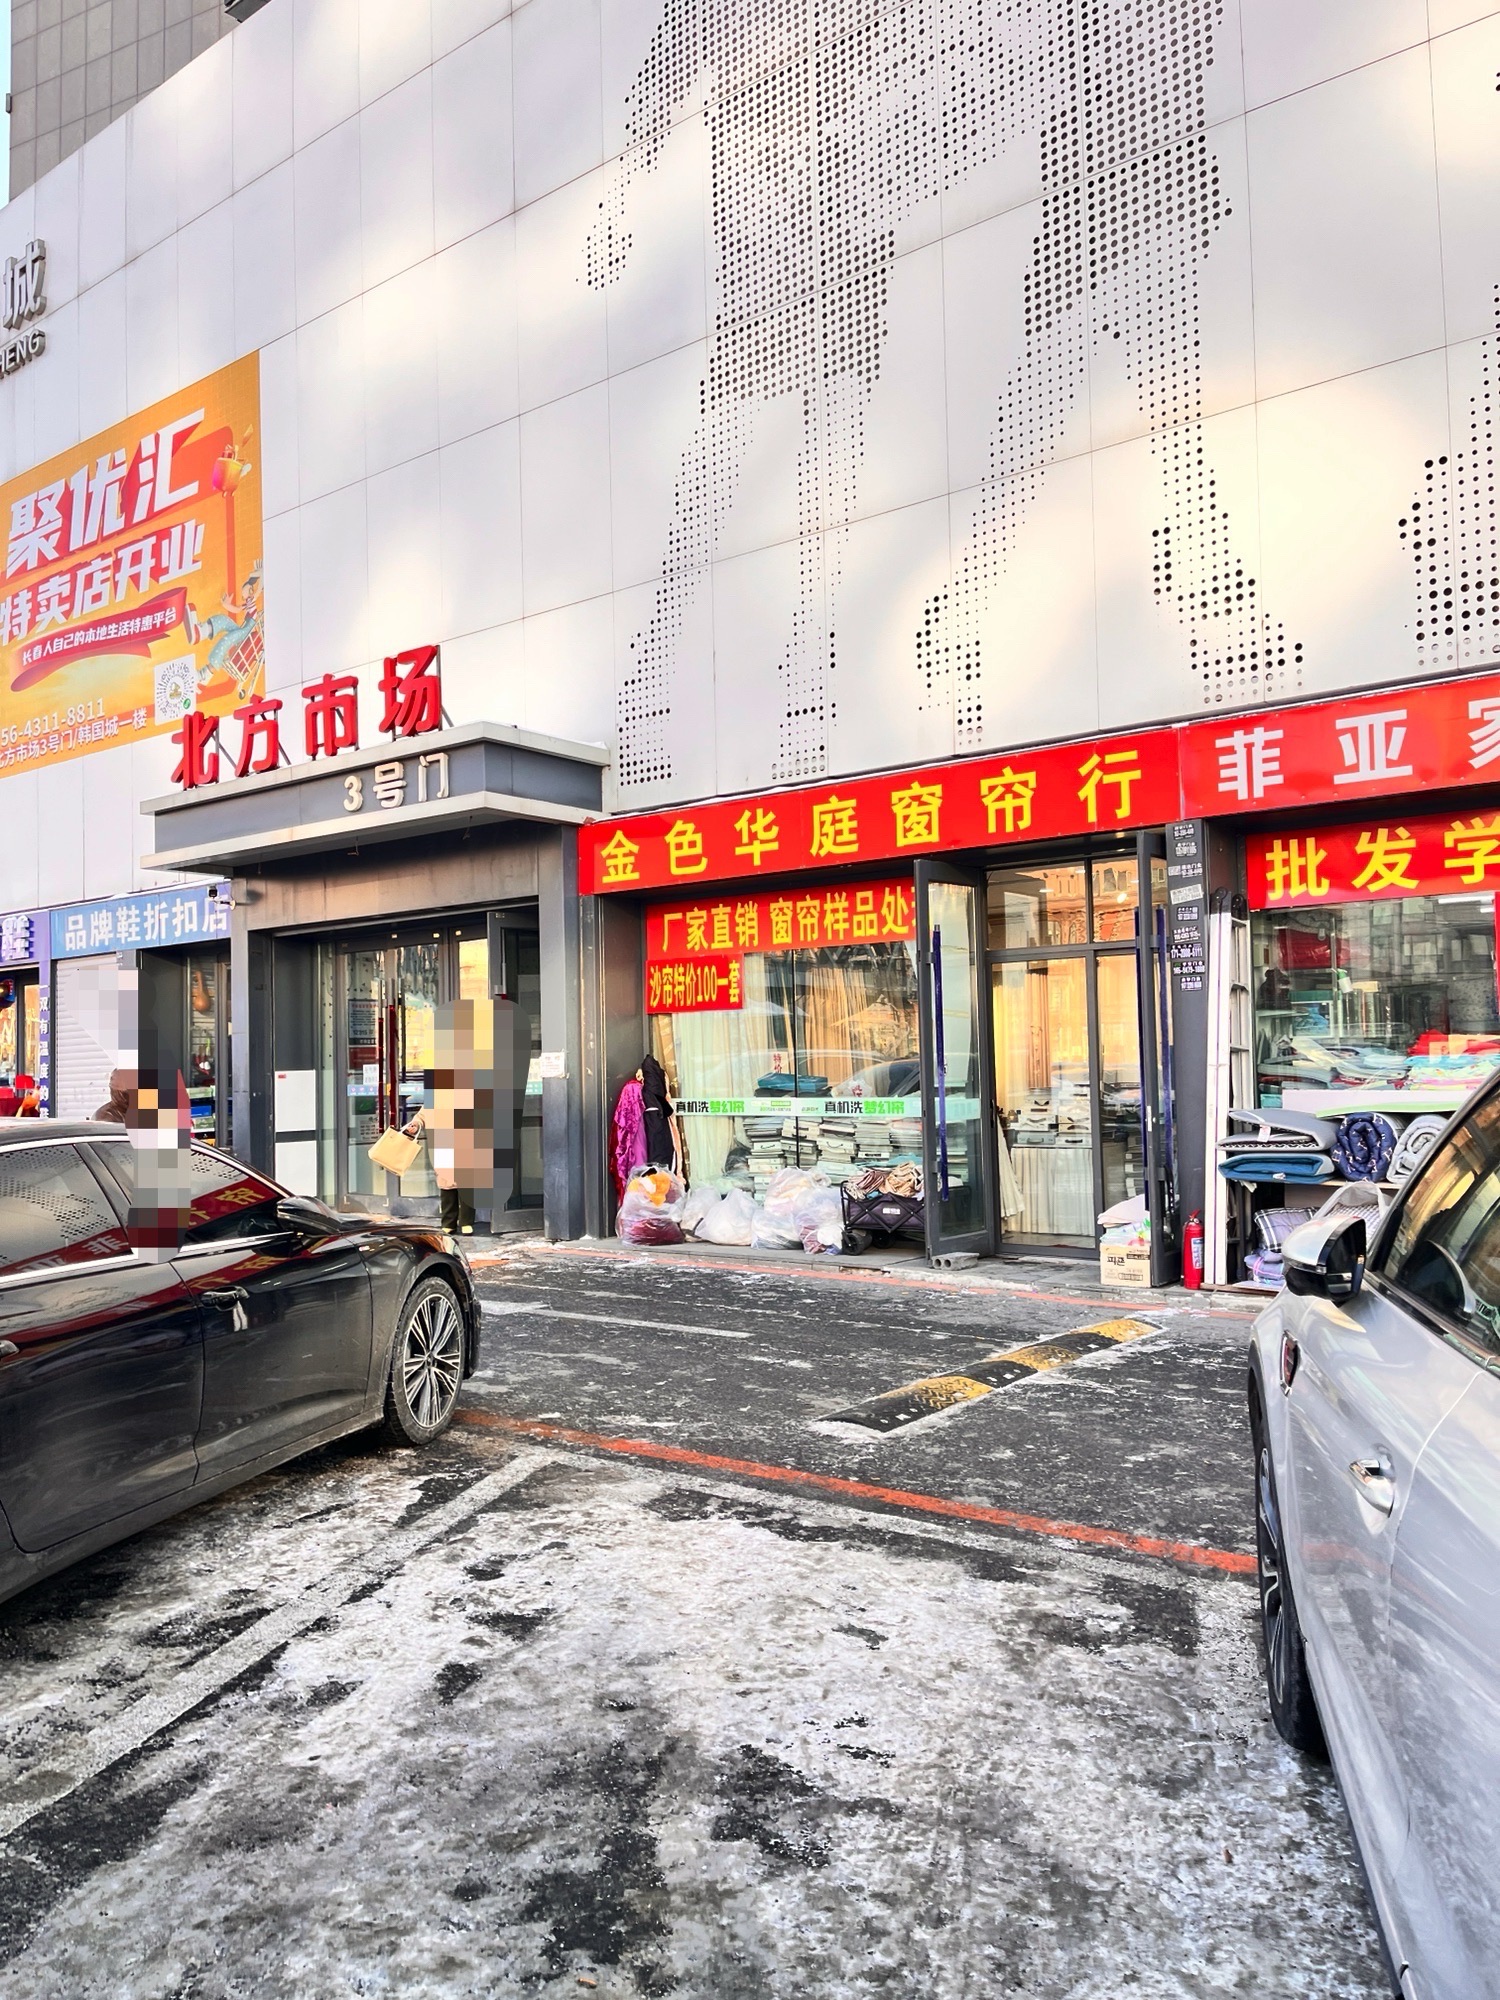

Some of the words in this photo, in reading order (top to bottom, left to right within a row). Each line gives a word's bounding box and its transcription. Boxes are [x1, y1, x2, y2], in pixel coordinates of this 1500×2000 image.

[3, 238, 47, 330] 城
[6, 408, 205, 579] 聚优汇
[0, 519, 205, 646] 特卖店开业
[22, 606, 177, 666] 长春人自己的本地生活特惠平台
[171, 645, 441, 789] 北方市场
[343, 752, 450, 812] 3号门
[601, 749, 1142, 884] 金色华庭窗帘行
[1265, 816, 1500, 902] 批发学
[64, 897, 227, 951] 品牌鞋折扣店
[662, 900, 759, 952] 厂家直销
[769, 886, 916, 945] 窗帘样品处
[649, 959, 741, 1008] 沙帘特价100一套
